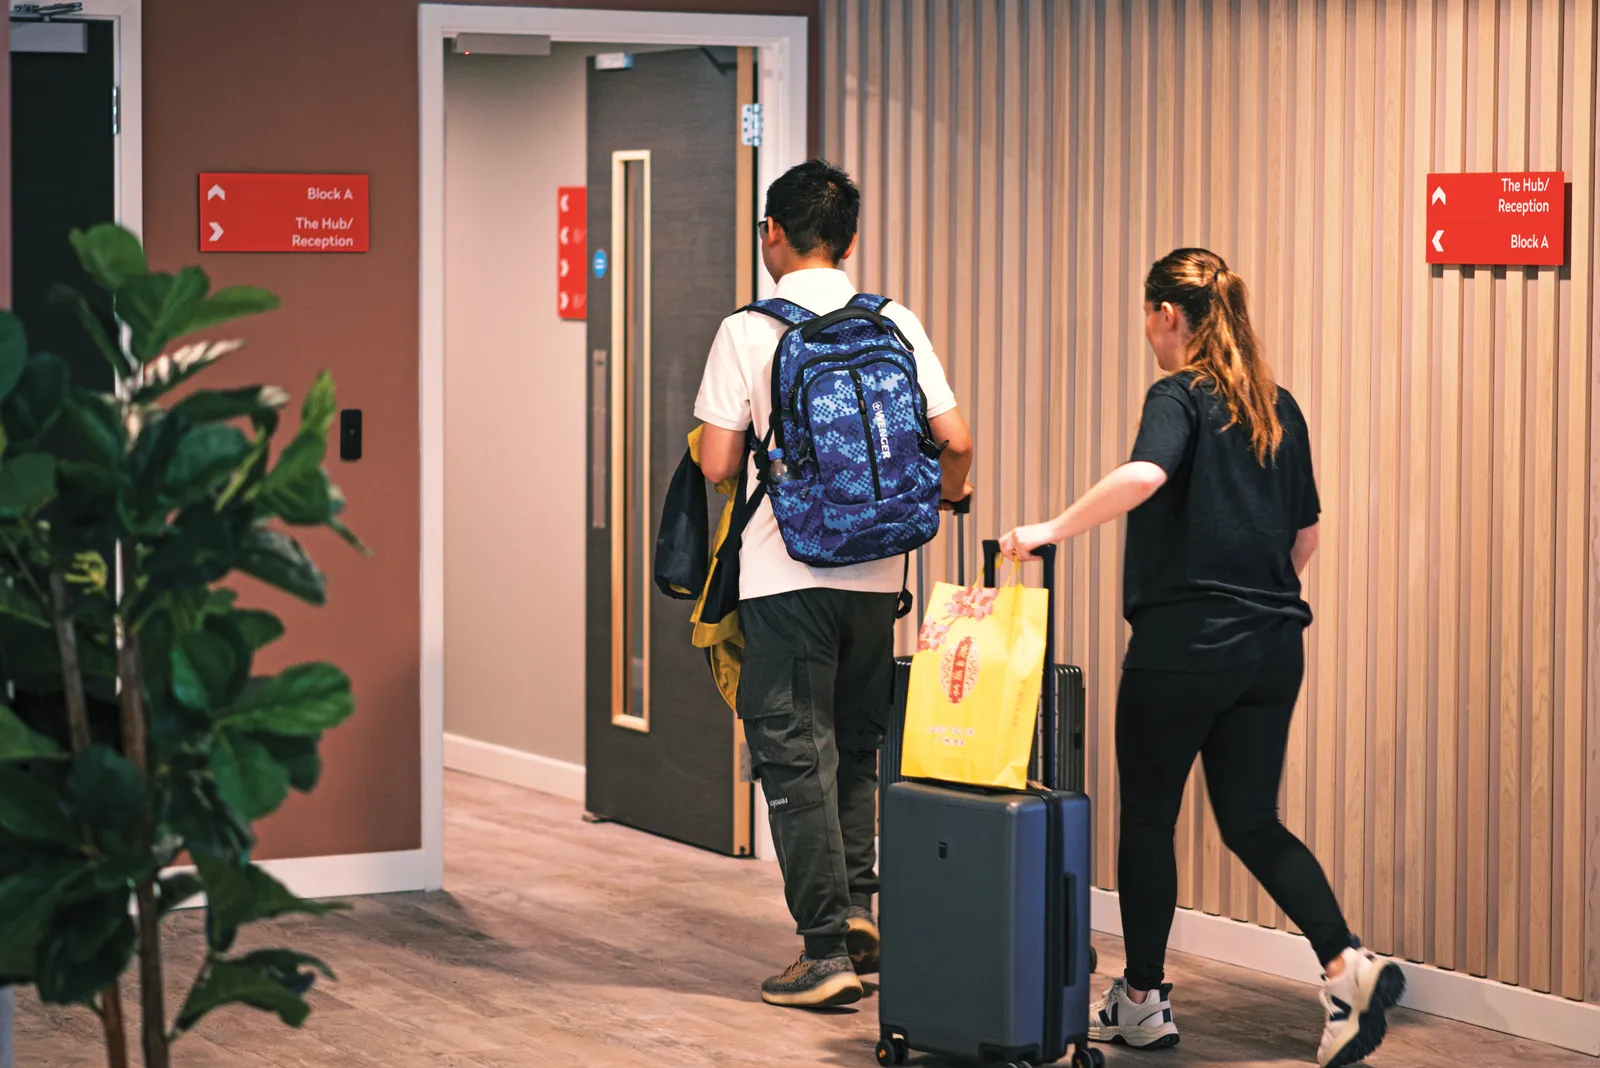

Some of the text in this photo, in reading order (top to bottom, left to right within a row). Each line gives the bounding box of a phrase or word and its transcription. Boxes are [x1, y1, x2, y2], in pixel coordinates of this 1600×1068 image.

[1501, 177, 1550, 192] The Hub/
[307, 187, 353, 200] Block A
[1498, 198, 1549, 216] Reception
[295, 217, 354, 230] The Hub/
[292, 234, 353, 250] Reception
[1510, 233, 1549, 249] Block A
[875, 410, 891, 459] WENGER
